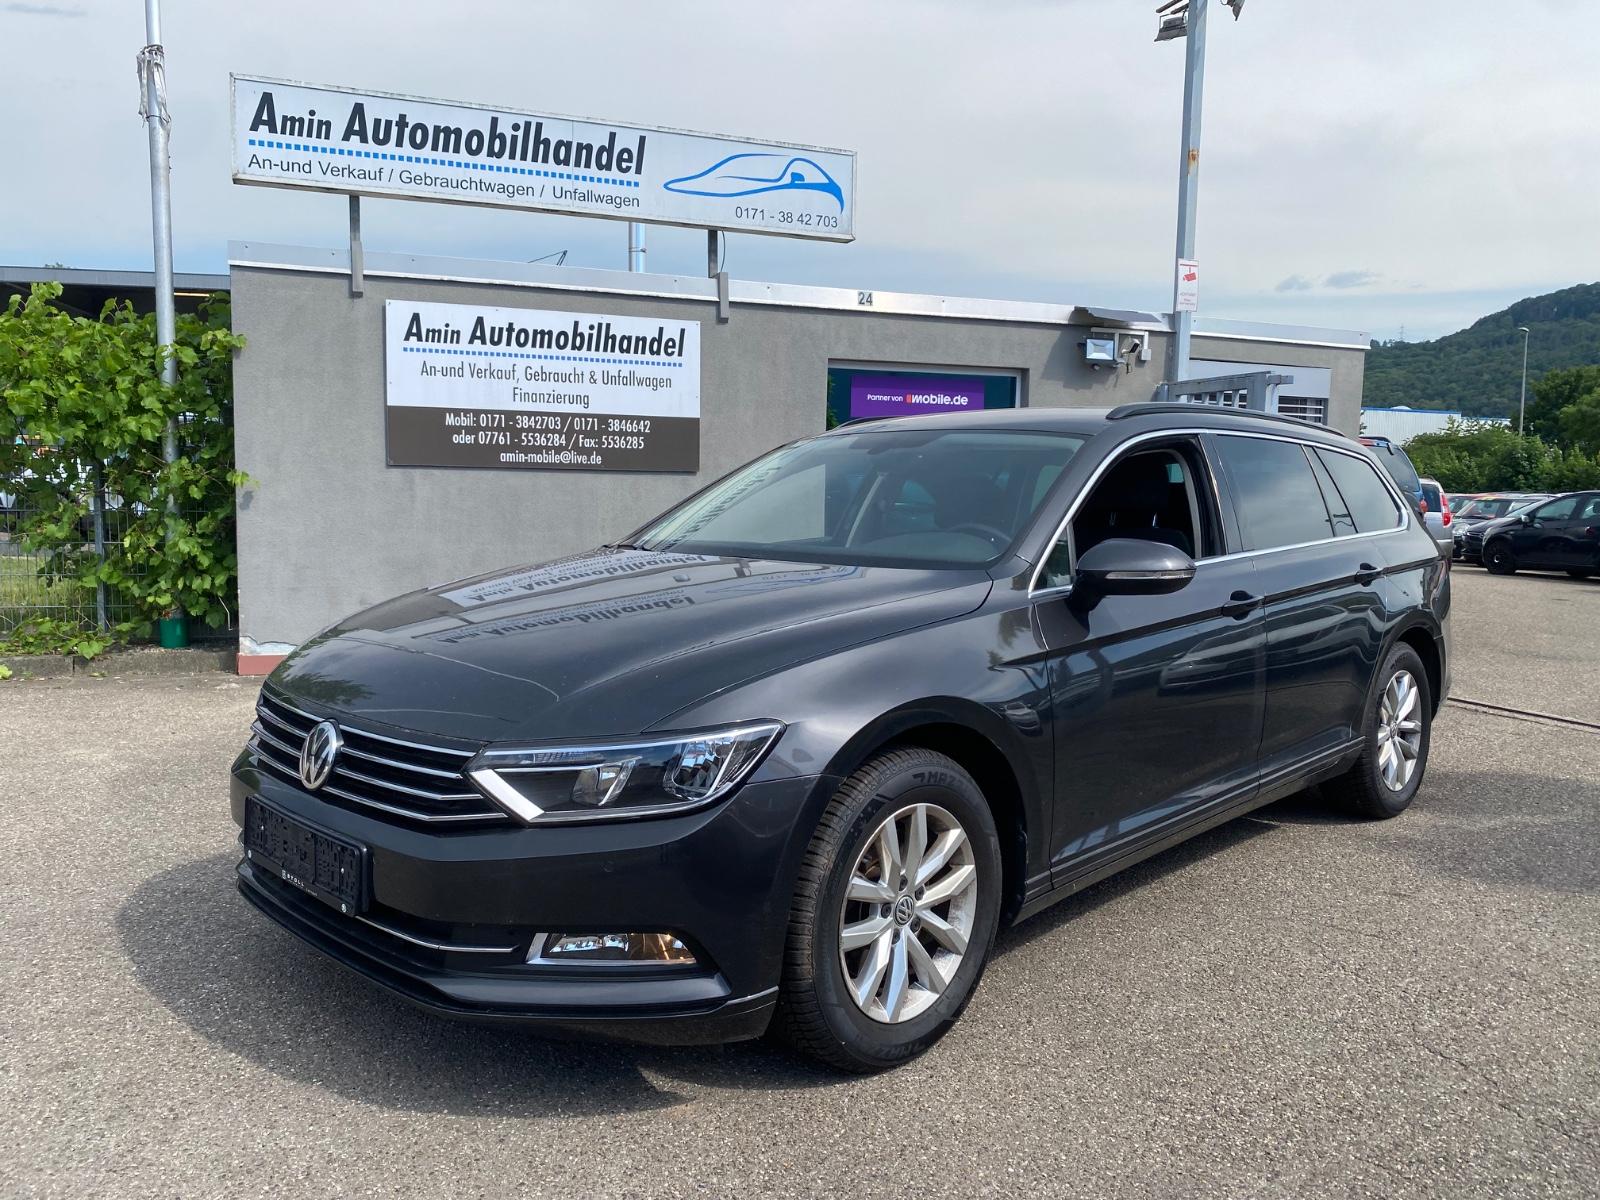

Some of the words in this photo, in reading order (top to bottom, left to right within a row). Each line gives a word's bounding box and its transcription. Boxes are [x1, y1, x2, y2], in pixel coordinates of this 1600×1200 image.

[249, 91, 332, 140] Amin
[341, 102, 647, 175] Automobilhandel
[248, 153, 312, 174] An-und
[318, 160, 384, 182] Verkauf
[387, 168, 394, 183] /
[399, 170, 535, 198] Gebrauchtwagen
[539, 184, 546, 199] /
[552, 185, 640, 209] Unfallwagen
[735, 206, 765, 221] 0171
[778, 210, 793, 224] 38
[797, 213, 812, 226] 42
[816, 214, 838, 229] 703
[858, 292, 873, 306] 24
[403, 312, 461, 345] Amin
[468, 316, 686, 357] Automobilhandel
[420, 360, 464, 378] An-und
[468, 362, 520, 383] Verkauf,
[524, 365, 584, 384] Gebraucht
[588, 370, 597, 385] &
[602, 369, 672, 391] Unfallwagen
[512, 386, 590, 409] Finanzierung
[867, 394, 891, 402] Partner
[912, 394, 969, 405] mobile.de
[445, 412, 477, 427] Mobil:
[480, 414, 505, 428] 0171
[516, 415, 561, 429] 3842703
[563, 416, 572, 432] /
[574, 417, 598, 431] 0171
[607, 418, 651, 433] 3846642
[452, 430, 476, 444] oder
[478, 432, 511, 445] 07761
[521, 433, 566, 447] 5536284
[568, 433, 577, 450] /
[579, 435, 599, 448] Fax:
[601, 436, 644, 449] 5536285
[500, 450, 602, 465] amin-mobile@live.de
